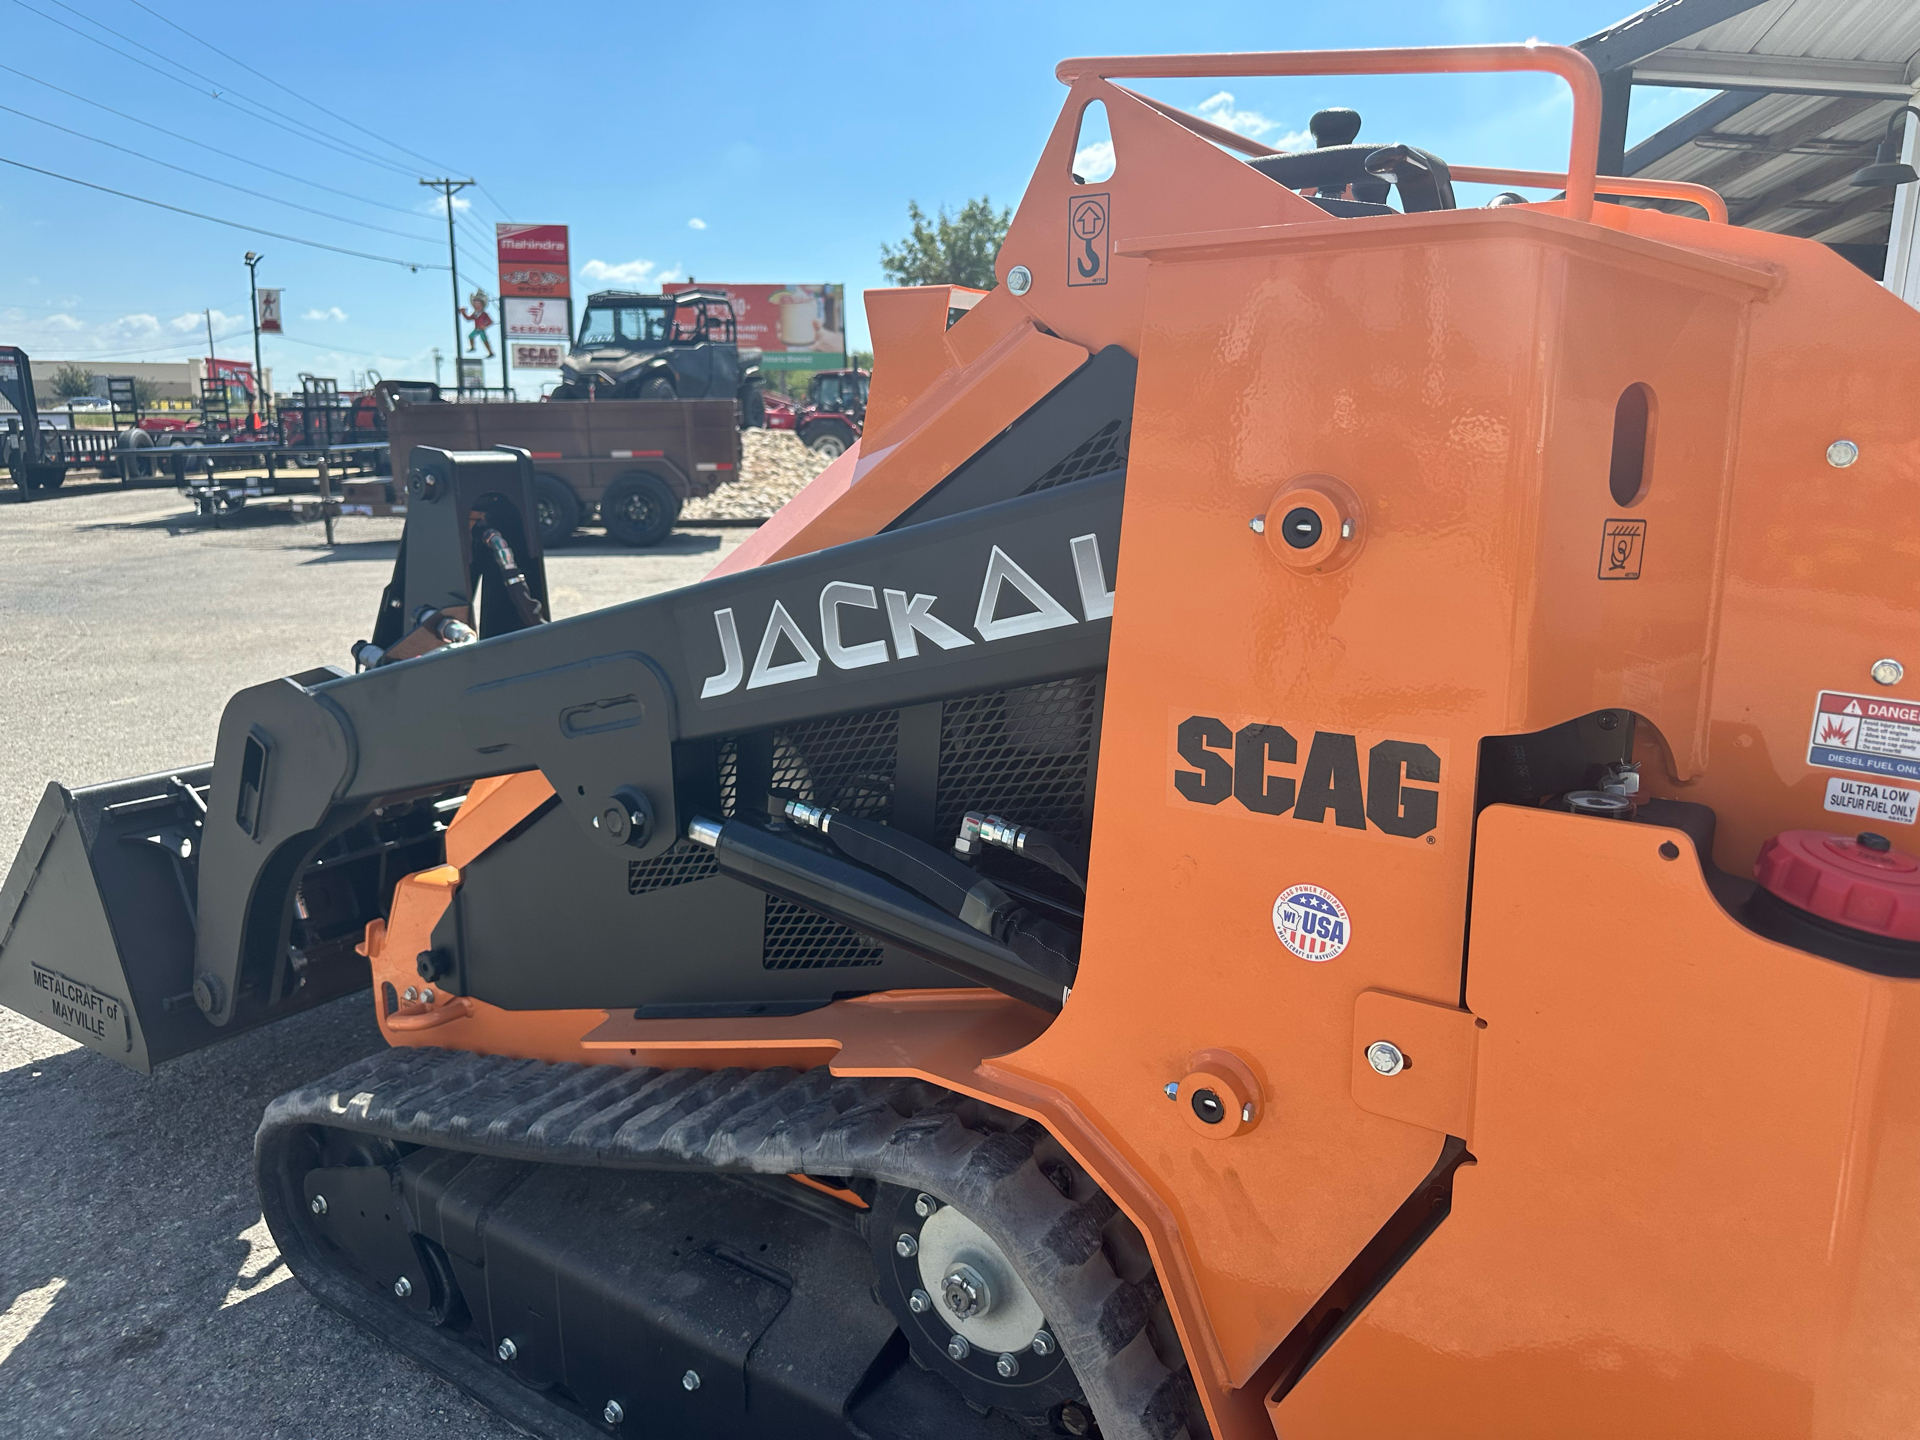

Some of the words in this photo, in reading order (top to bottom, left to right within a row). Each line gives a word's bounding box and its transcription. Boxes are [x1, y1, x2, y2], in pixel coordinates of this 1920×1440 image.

[501, 238, 565, 250] Mahindra
[511, 325, 563, 333] SEGWAY
[518, 347, 558, 360] SCAG
[700, 533, 1116, 698] JACKAL
[1868, 704, 1920, 721] DANGE
[1828, 753, 1864, 766] DIESEL
[1867, 759, 1893, 771] FUEL
[1897, 764, 1920, 775] ONL
[1174, 715, 1441, 839] SCAG
[1841, 782, 1878, 798] ULTRA
[1882, 789, 1909, 802] LOW
[1830, 794, 1864, 810] SULFUR
[1866, 799, 1888, 814] FUEL
[1890, 804, 1915, 818] ONLY
[1280, 889, 1294, 902] SCAG
[1319, 889, 1347, 920] EQUIPMENT
[1283, 910, 1296, 924] WI
[1302, 910, 1343, 945] USA
[1278, 930, 1305, 957] METALCRAFT
[1314, 948, 1339, 960] MAYVILLE
[33, 969, 104, 1014] METALCRAFT
[106, 1004, 118, 1020] of
[52, 999, 105, 1037] MAYVILLE
